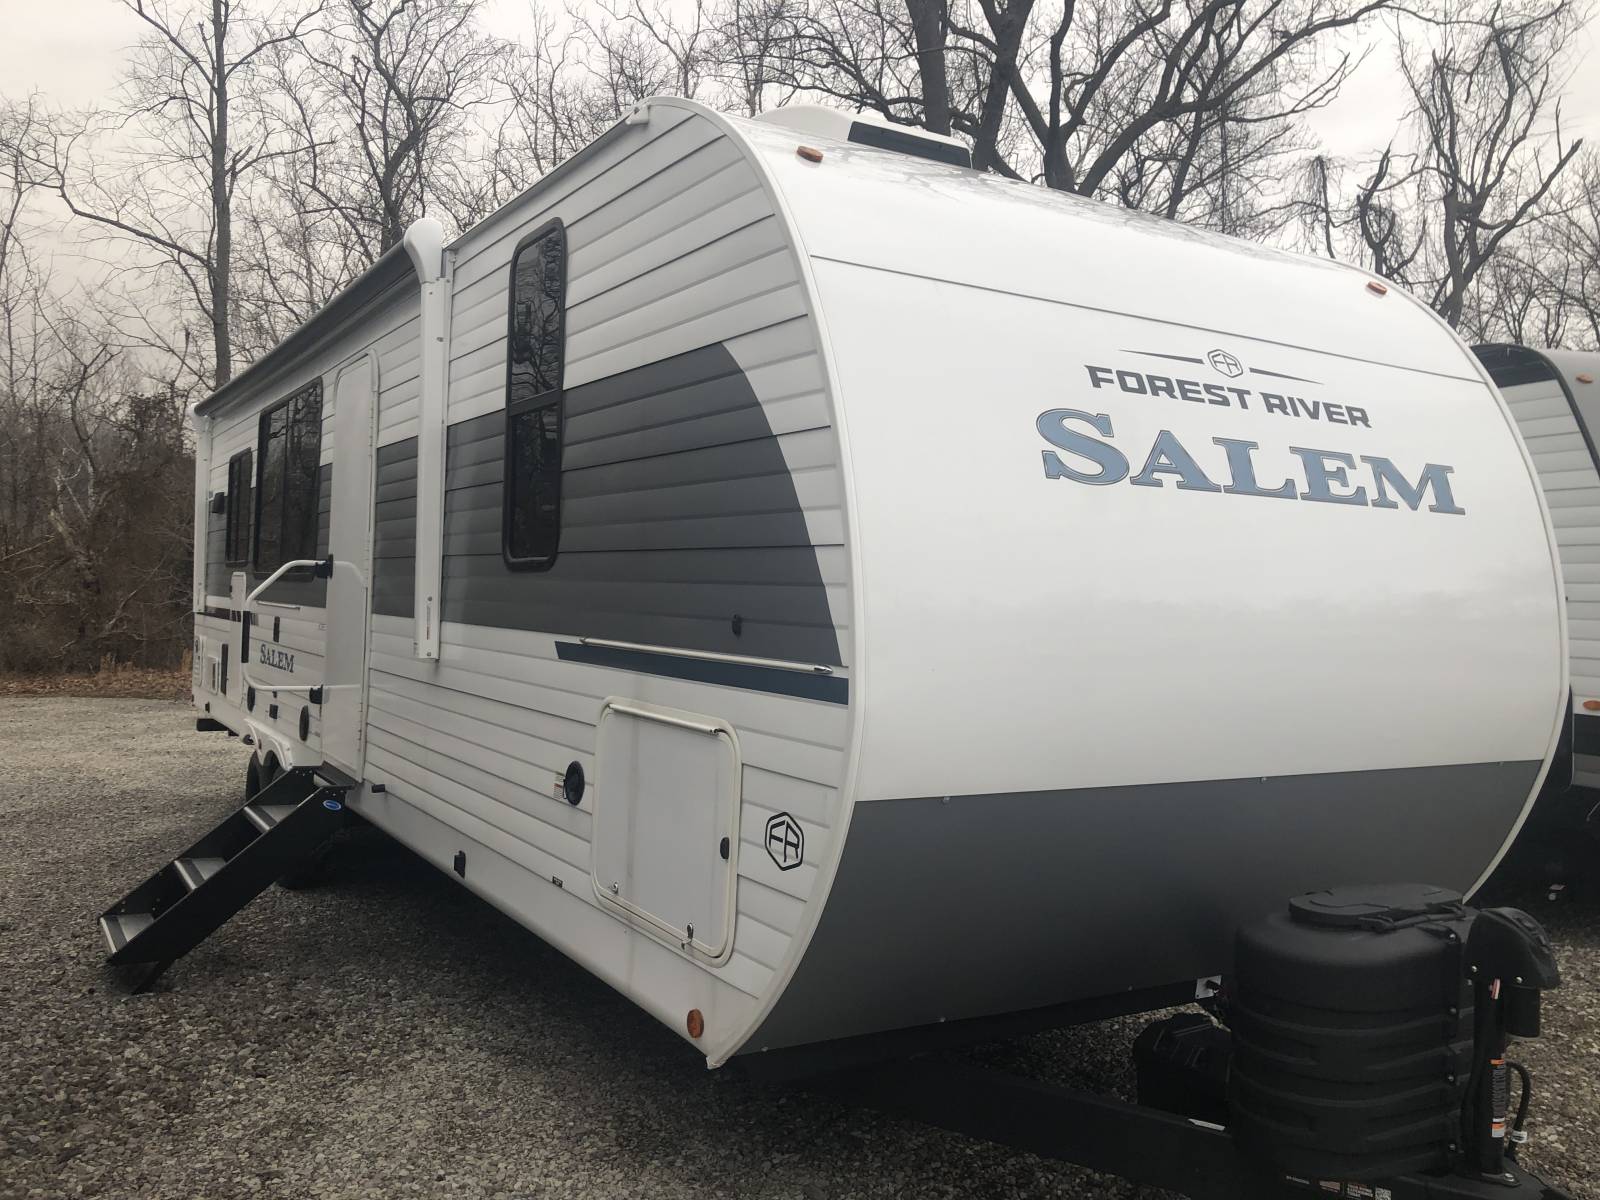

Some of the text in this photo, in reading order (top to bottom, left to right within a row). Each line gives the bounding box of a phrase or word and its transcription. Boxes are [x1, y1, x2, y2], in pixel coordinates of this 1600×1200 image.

[1085, 365, 1372, 428] FOREST RIVER
[1036, 408, 1466, 515] SALEM
[260, 643, 295, 673] SALEM
